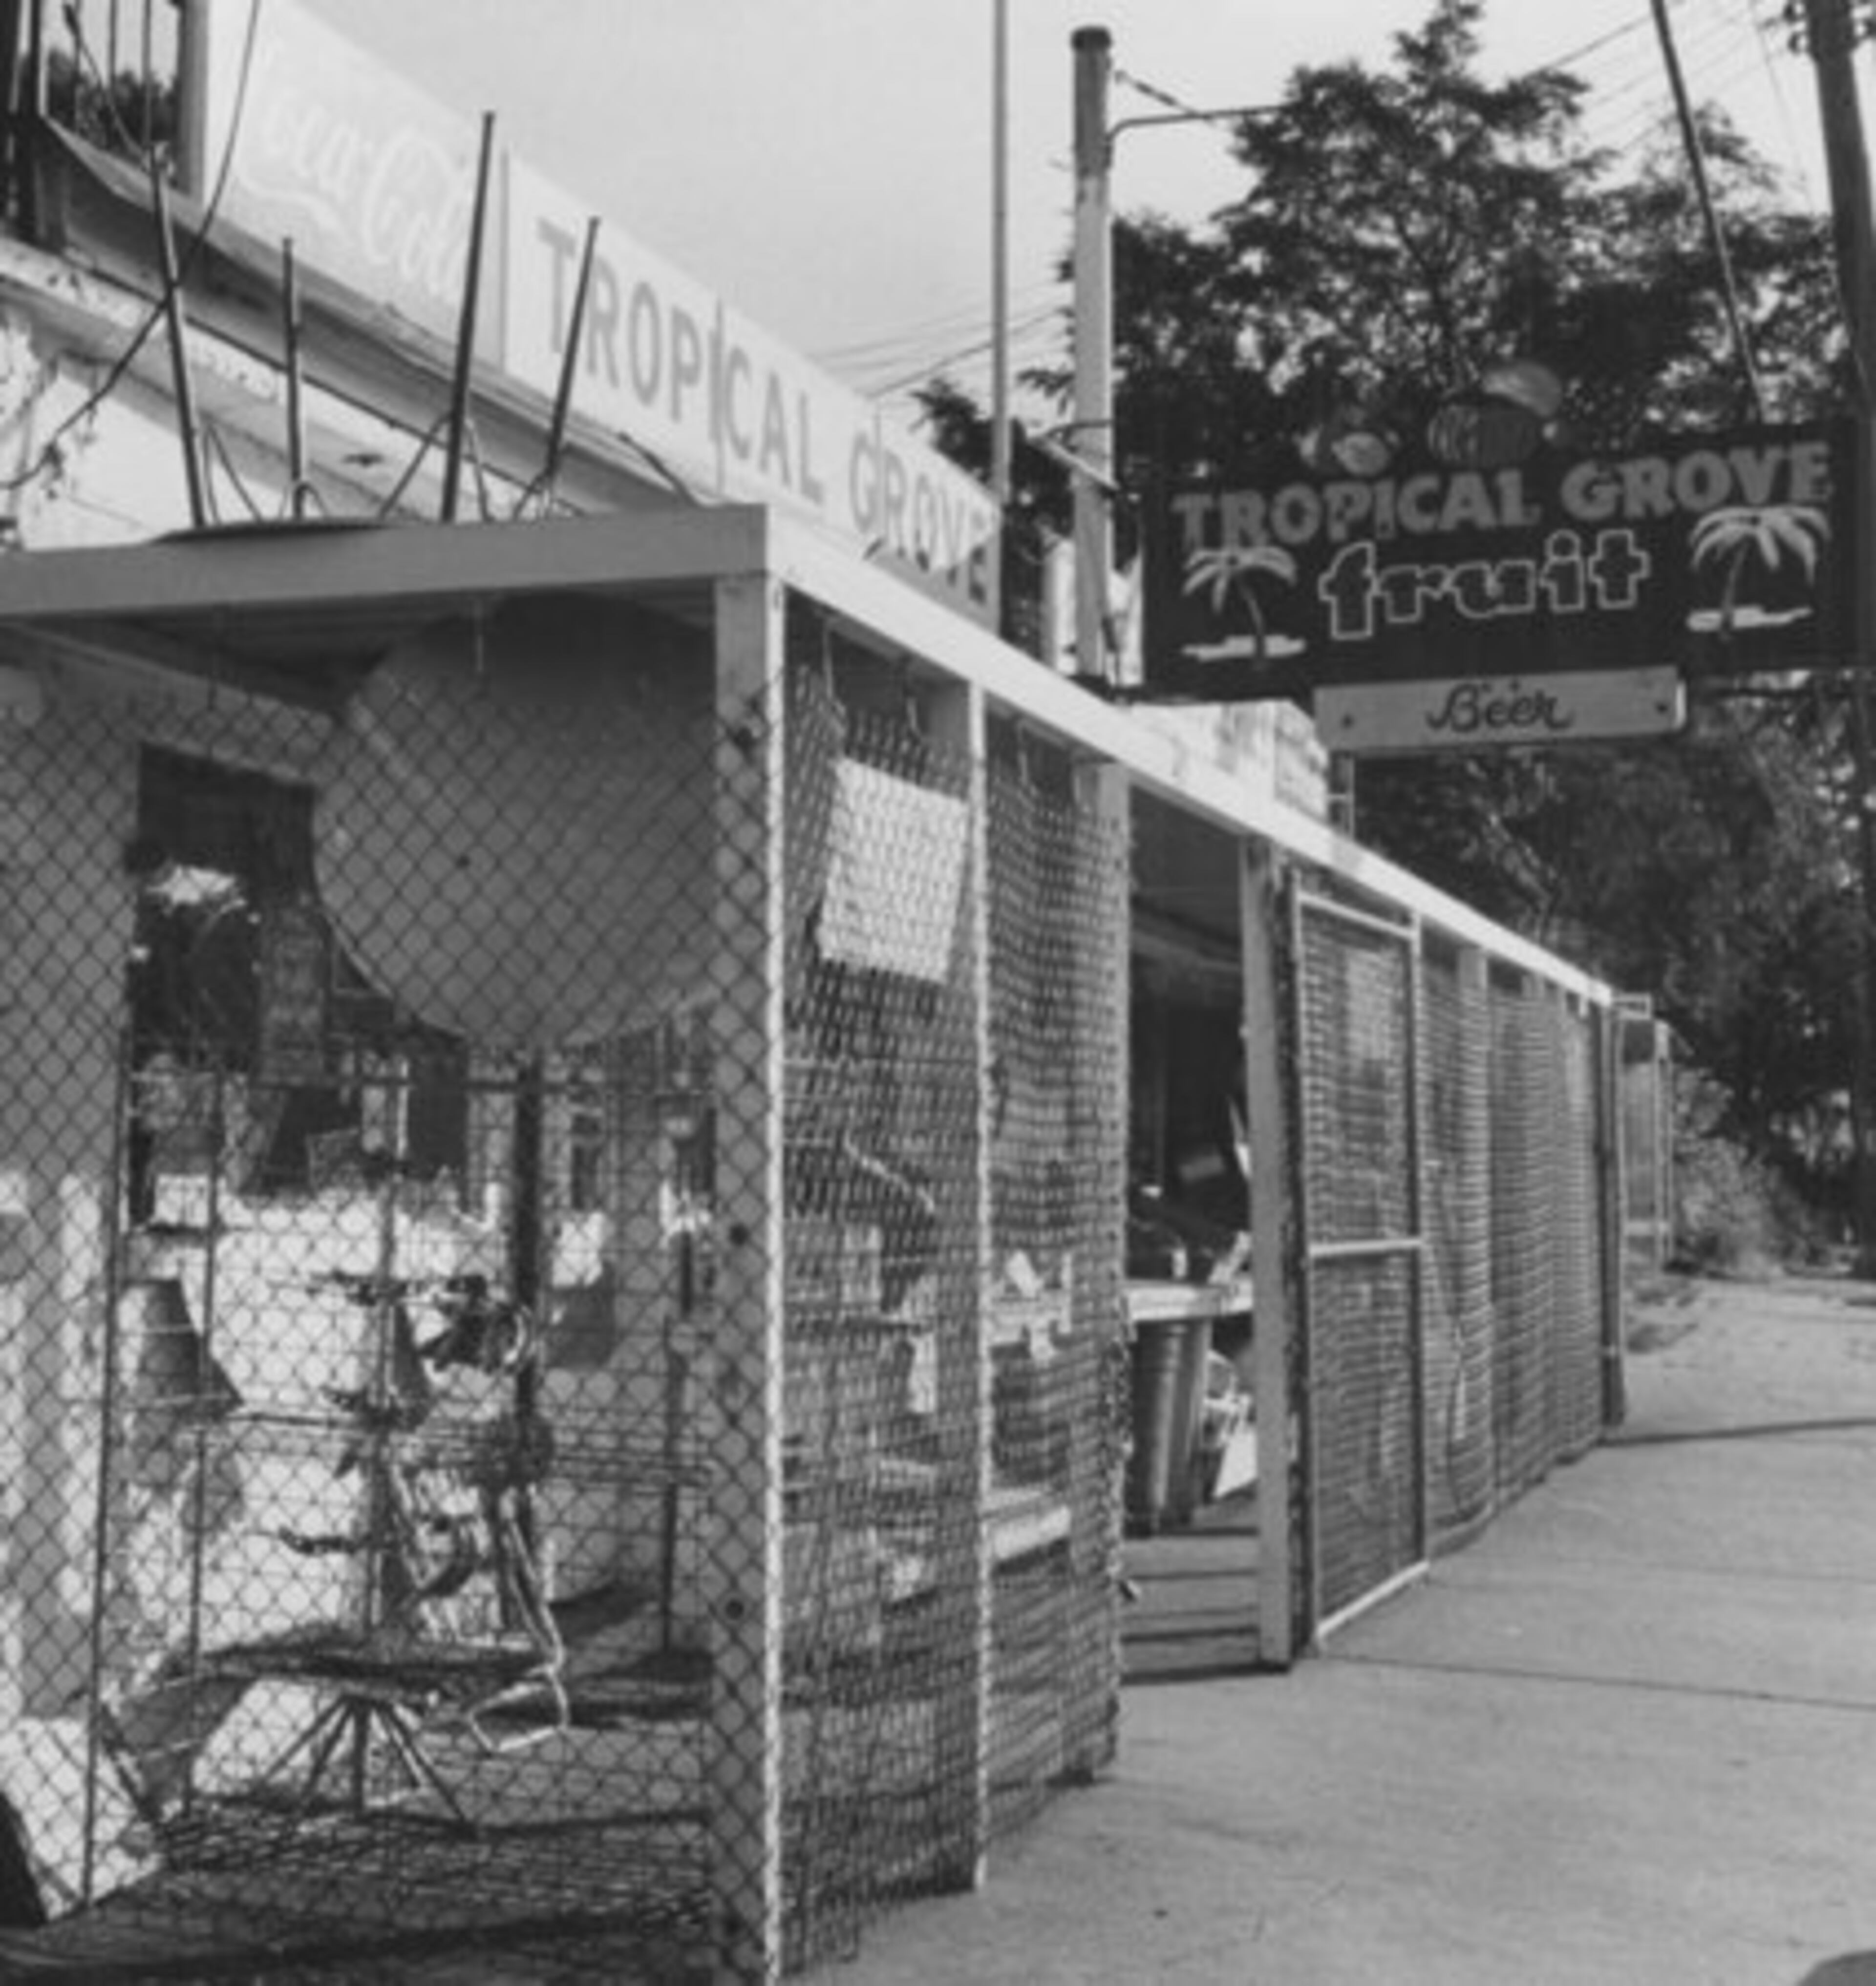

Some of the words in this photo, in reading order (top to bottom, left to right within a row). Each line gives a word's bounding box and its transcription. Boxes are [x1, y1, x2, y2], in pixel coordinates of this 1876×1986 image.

[537, 216, 826, 506] TROPICAL
[849, 428, 991, 605] GROVE
[1172, 471, 1542, 548] TROPICAL
[1561, 441, 1832, 520] GROVE
[1318, 529, 1650, 641] fruit
[1426, 685, 1574, 733] Beer
